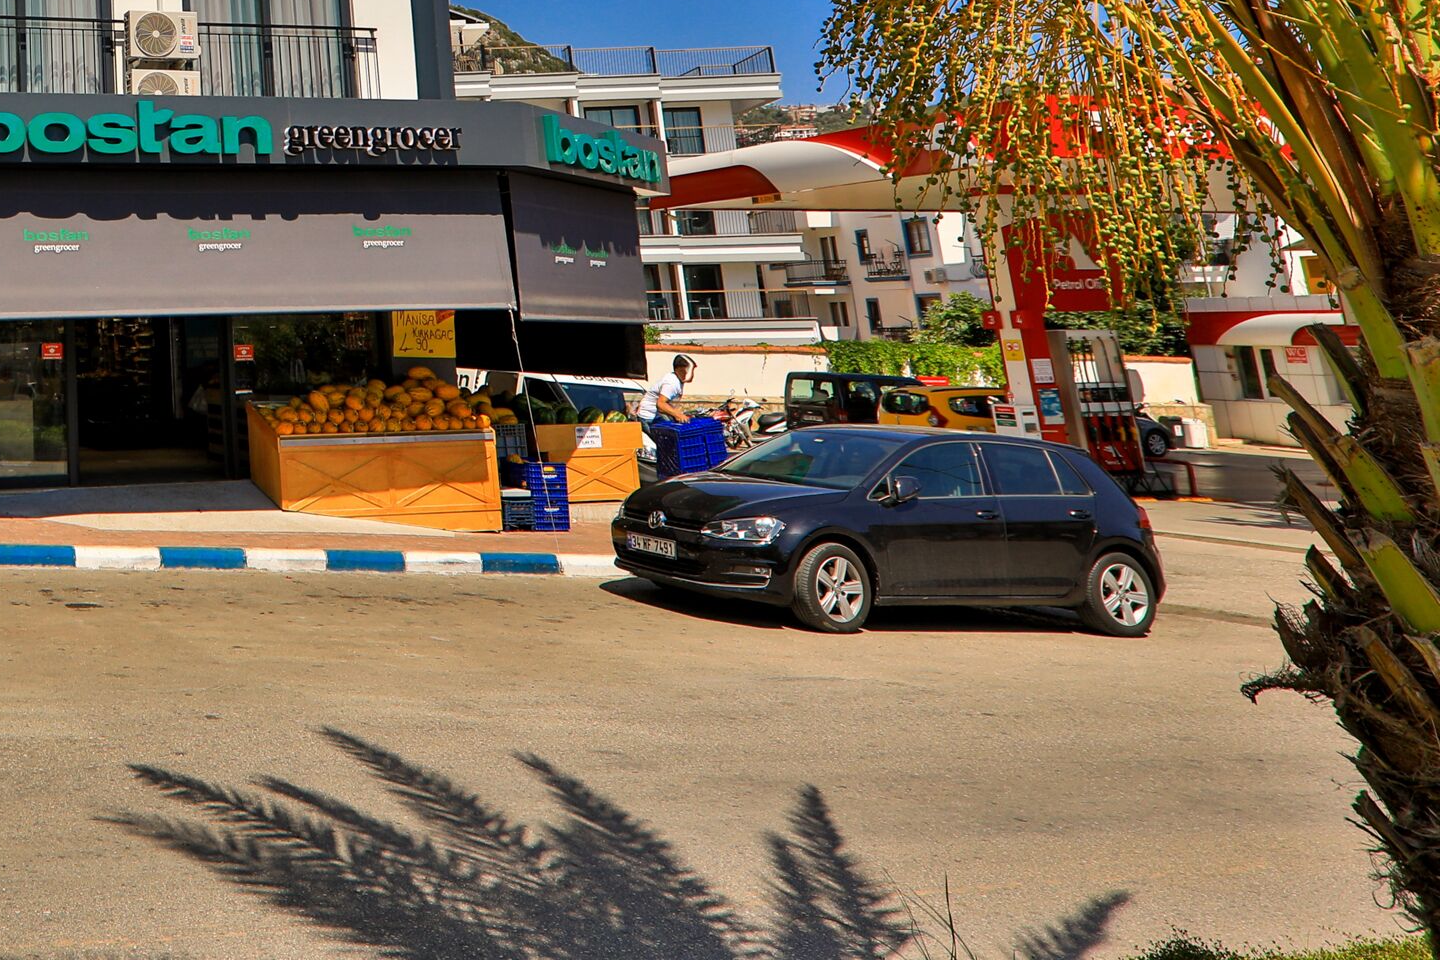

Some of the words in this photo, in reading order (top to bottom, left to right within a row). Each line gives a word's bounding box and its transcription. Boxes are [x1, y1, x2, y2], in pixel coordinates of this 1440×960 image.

[284, 122, 462, 157] greengrocer
[543, 114, 661, 183] bostan
[22, 228, 90, 242] bostan
[187, 226, 252, 241] bostan
[351, 224, 412, 238] bostan
[34, 242, 80, 253] greengrocer
[198, 241, 243, 252] greengrocer
[363, 238, 404, 249] greengrocer
[632, 535, 641, 548] 34
[654, 540, 673, 556] 7491
